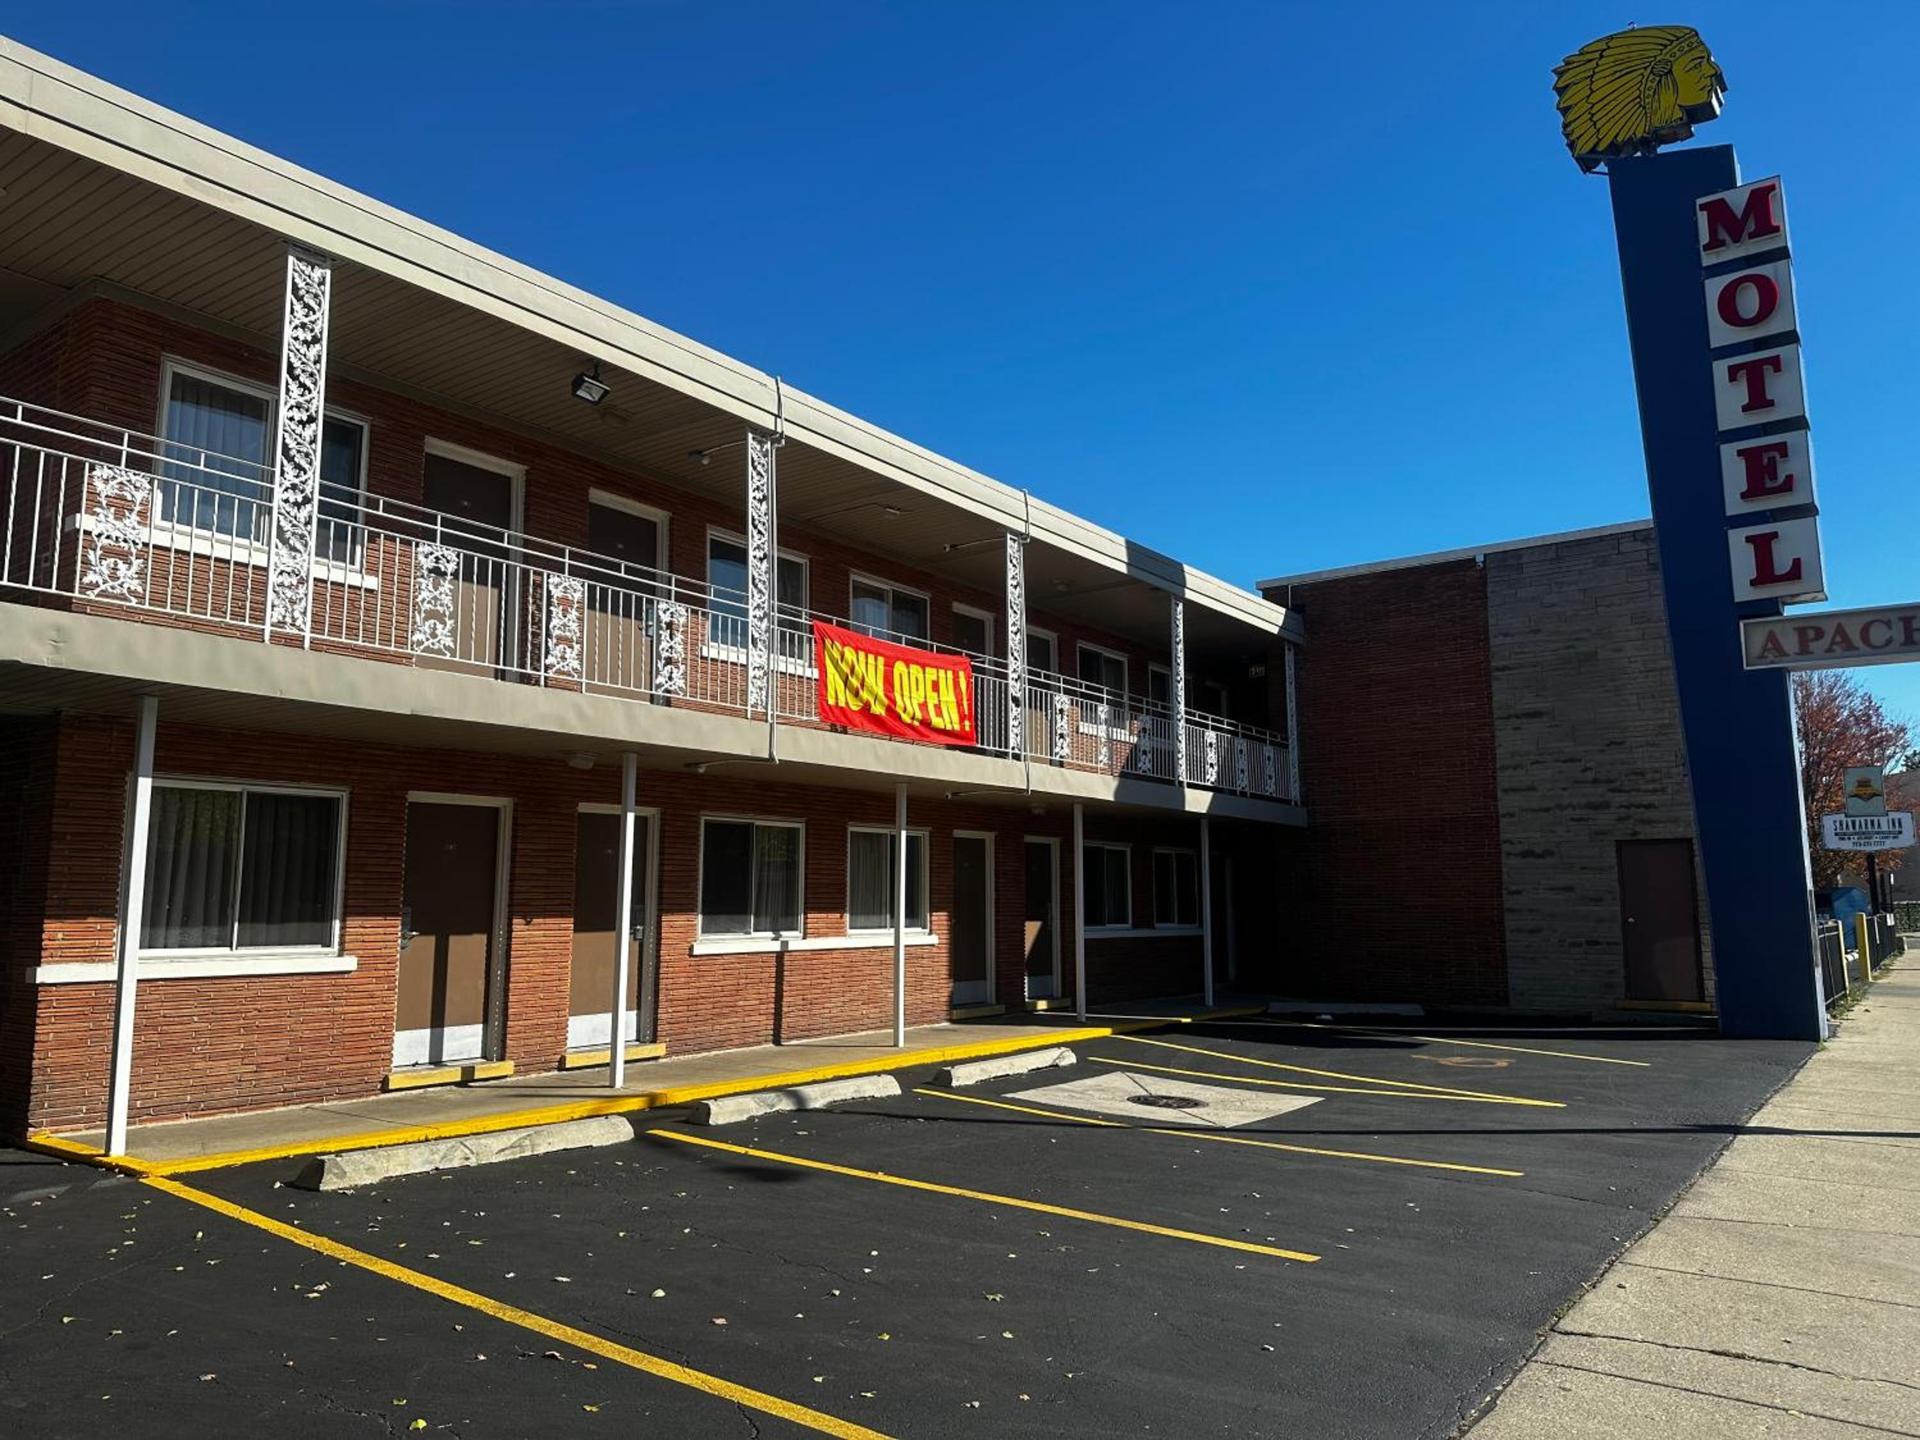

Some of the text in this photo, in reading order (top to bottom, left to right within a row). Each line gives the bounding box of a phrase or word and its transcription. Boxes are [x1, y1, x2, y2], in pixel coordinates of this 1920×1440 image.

[1699, 183, 1802, 588] MOTEL
[824, 638, 971, 732] NOW OPEN!
[1833, 817, 1903, 831] SHAWARMA INN
